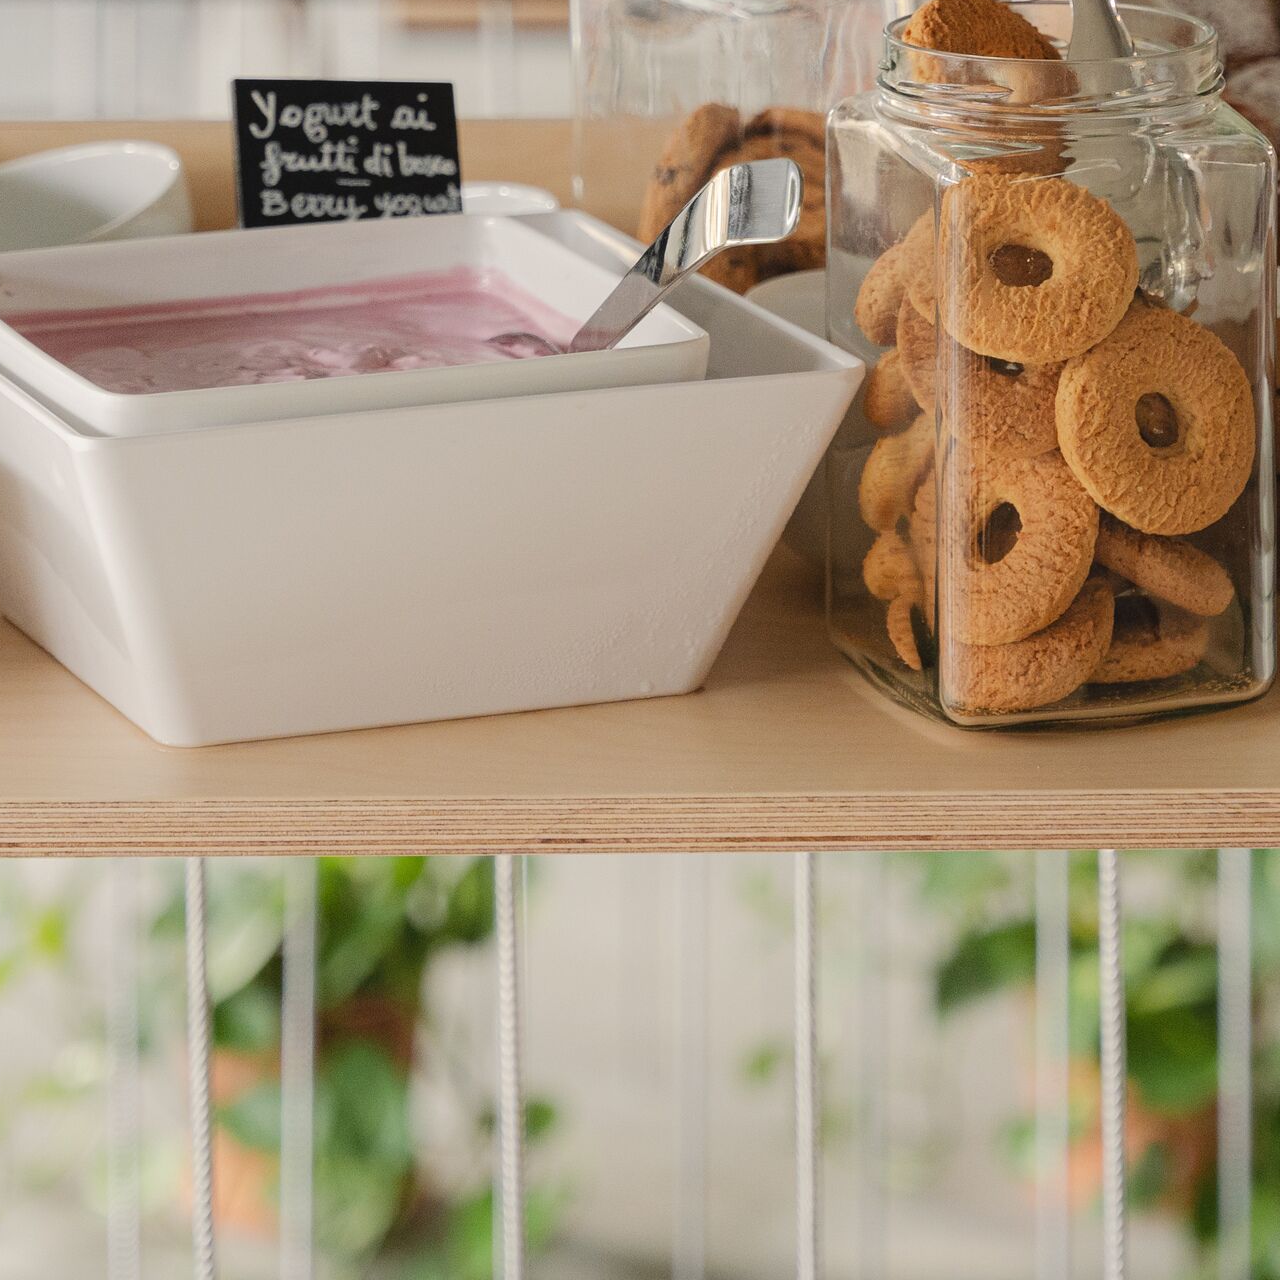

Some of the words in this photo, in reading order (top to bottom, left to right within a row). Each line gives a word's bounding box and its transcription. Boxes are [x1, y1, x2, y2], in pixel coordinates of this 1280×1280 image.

[249, 90, 380, 143] Yogurt
[390, 93, 437, 131] ai
[259, 135, 360, 187] frutti
[363, 142, 394, 177] di
